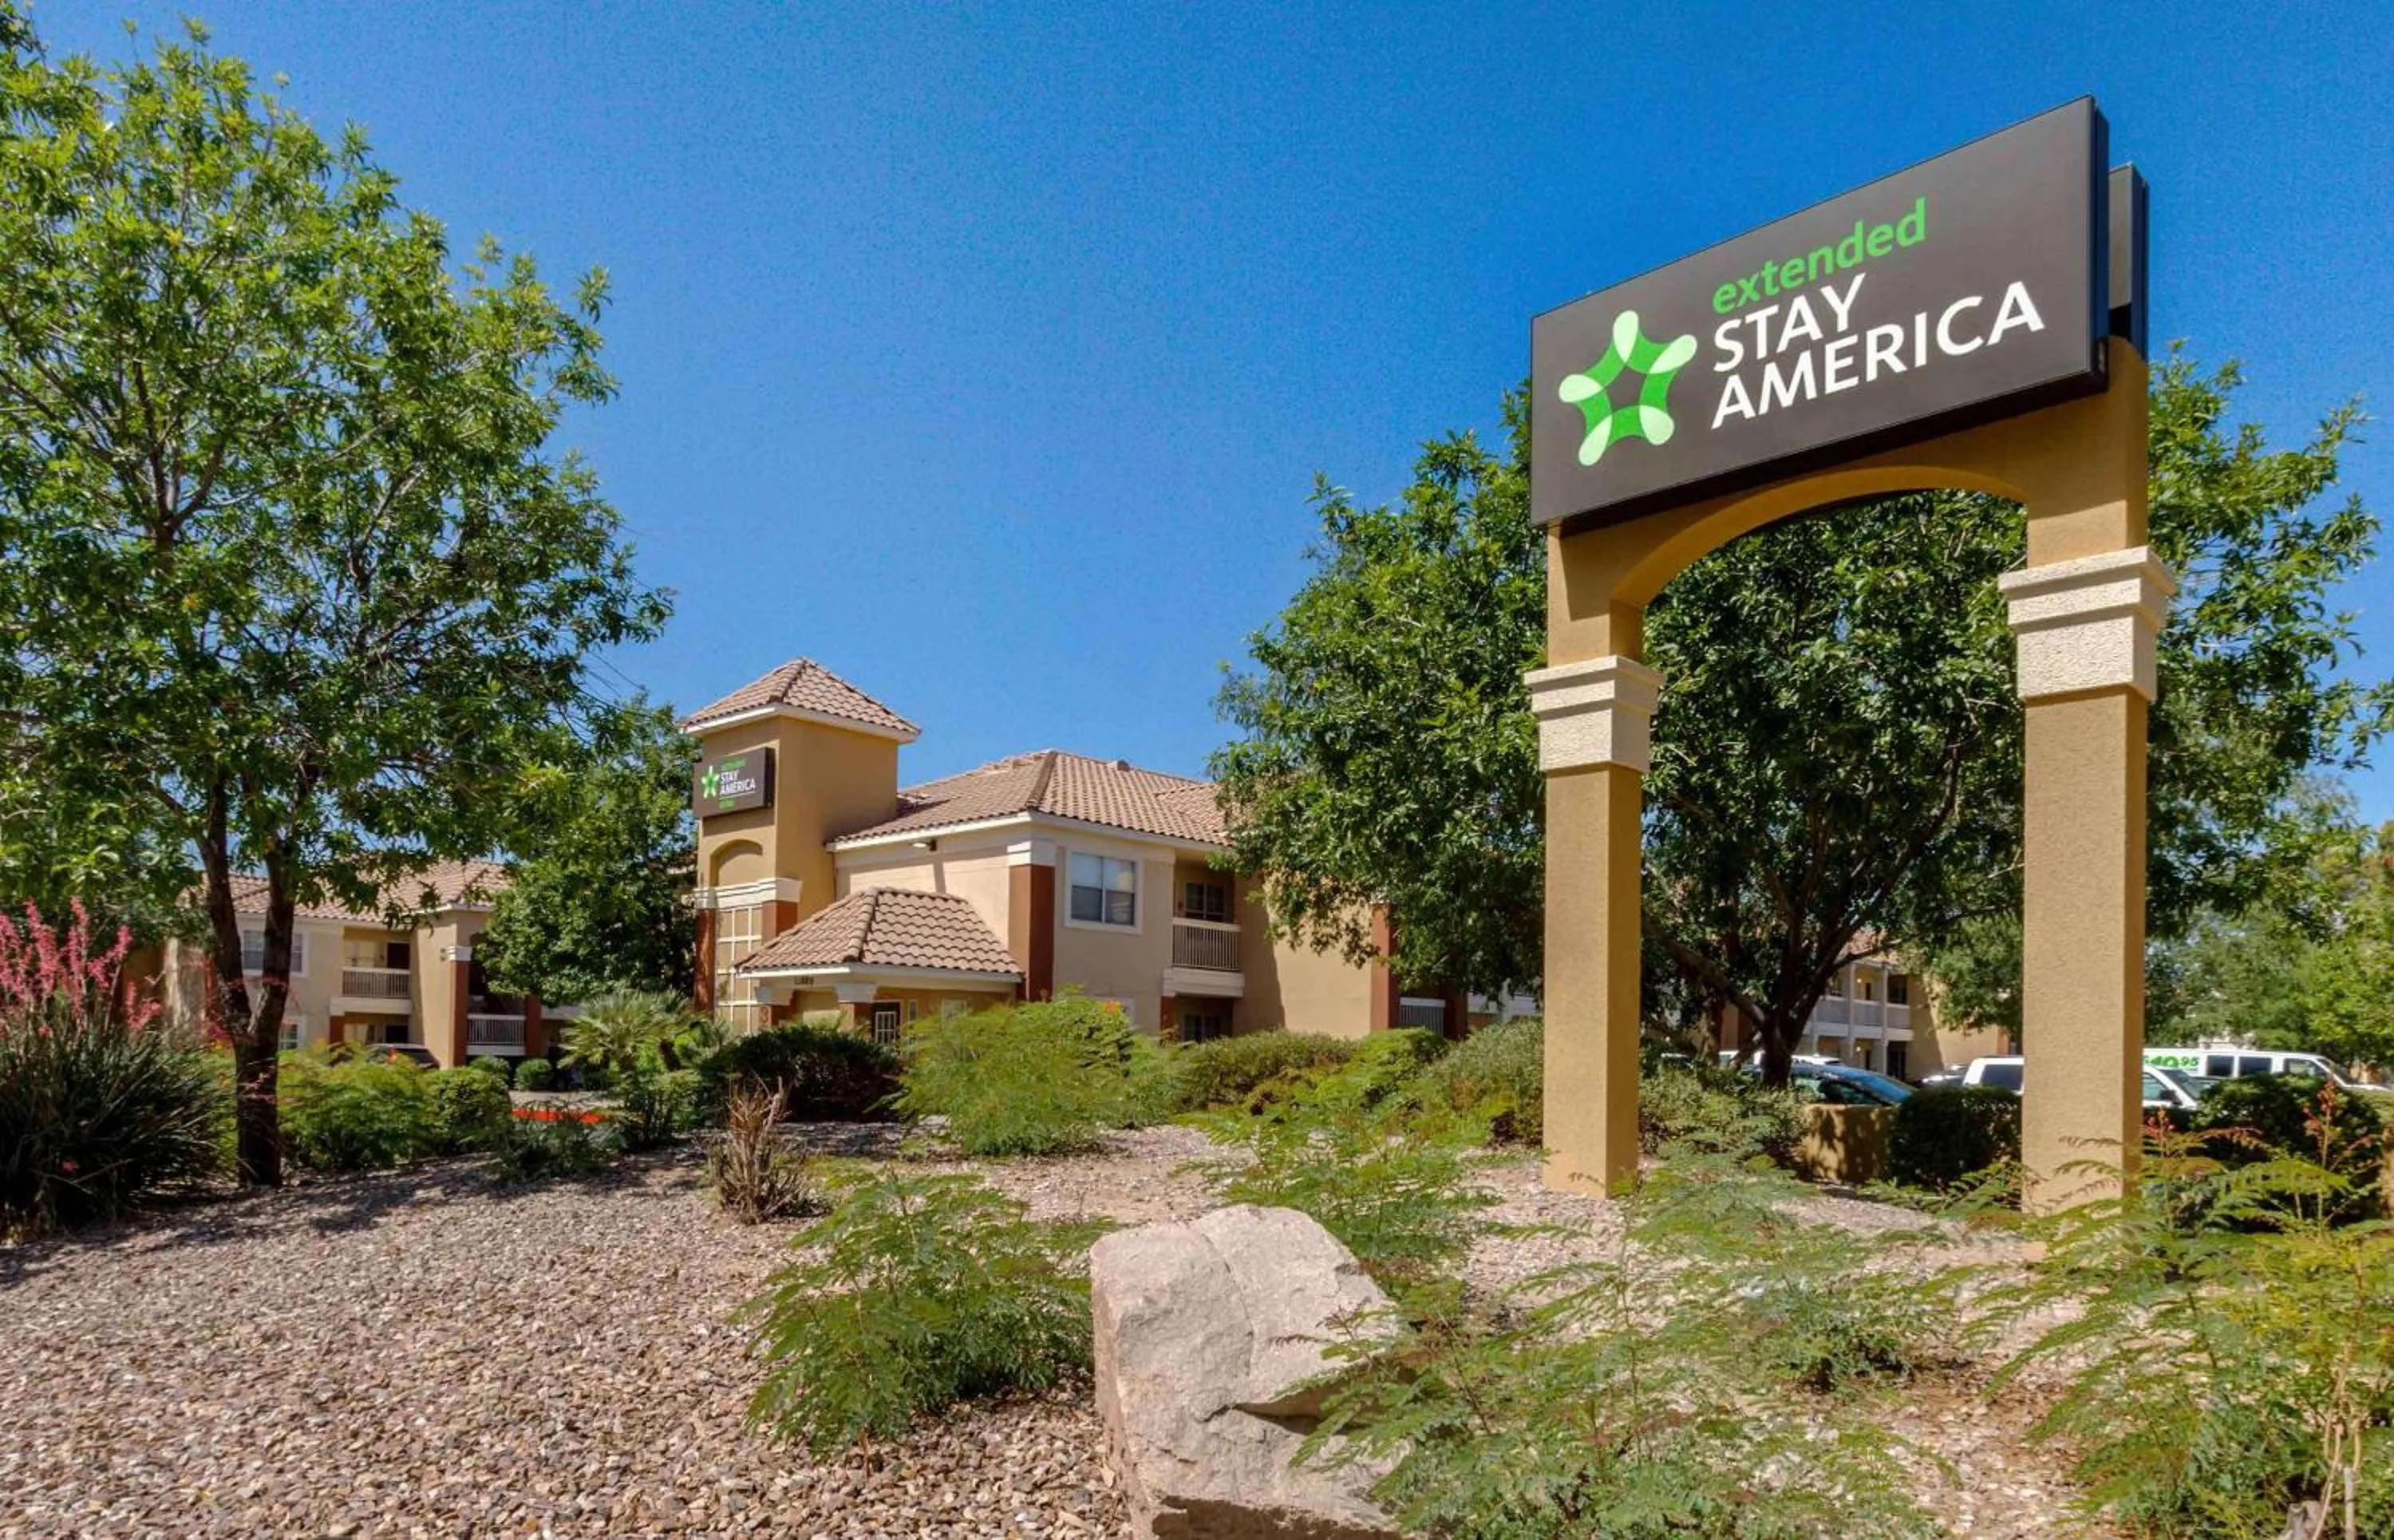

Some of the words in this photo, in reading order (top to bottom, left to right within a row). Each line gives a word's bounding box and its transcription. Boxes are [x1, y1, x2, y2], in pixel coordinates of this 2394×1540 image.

[1712, 197, 1926, 314] extended
[1710, 281, 2044, 430] AMERICA
[1713, 272, 1866, 373] STAY
[720, 769, 739, 781] STAY
[720, 778, 756, 795] AMERICA
